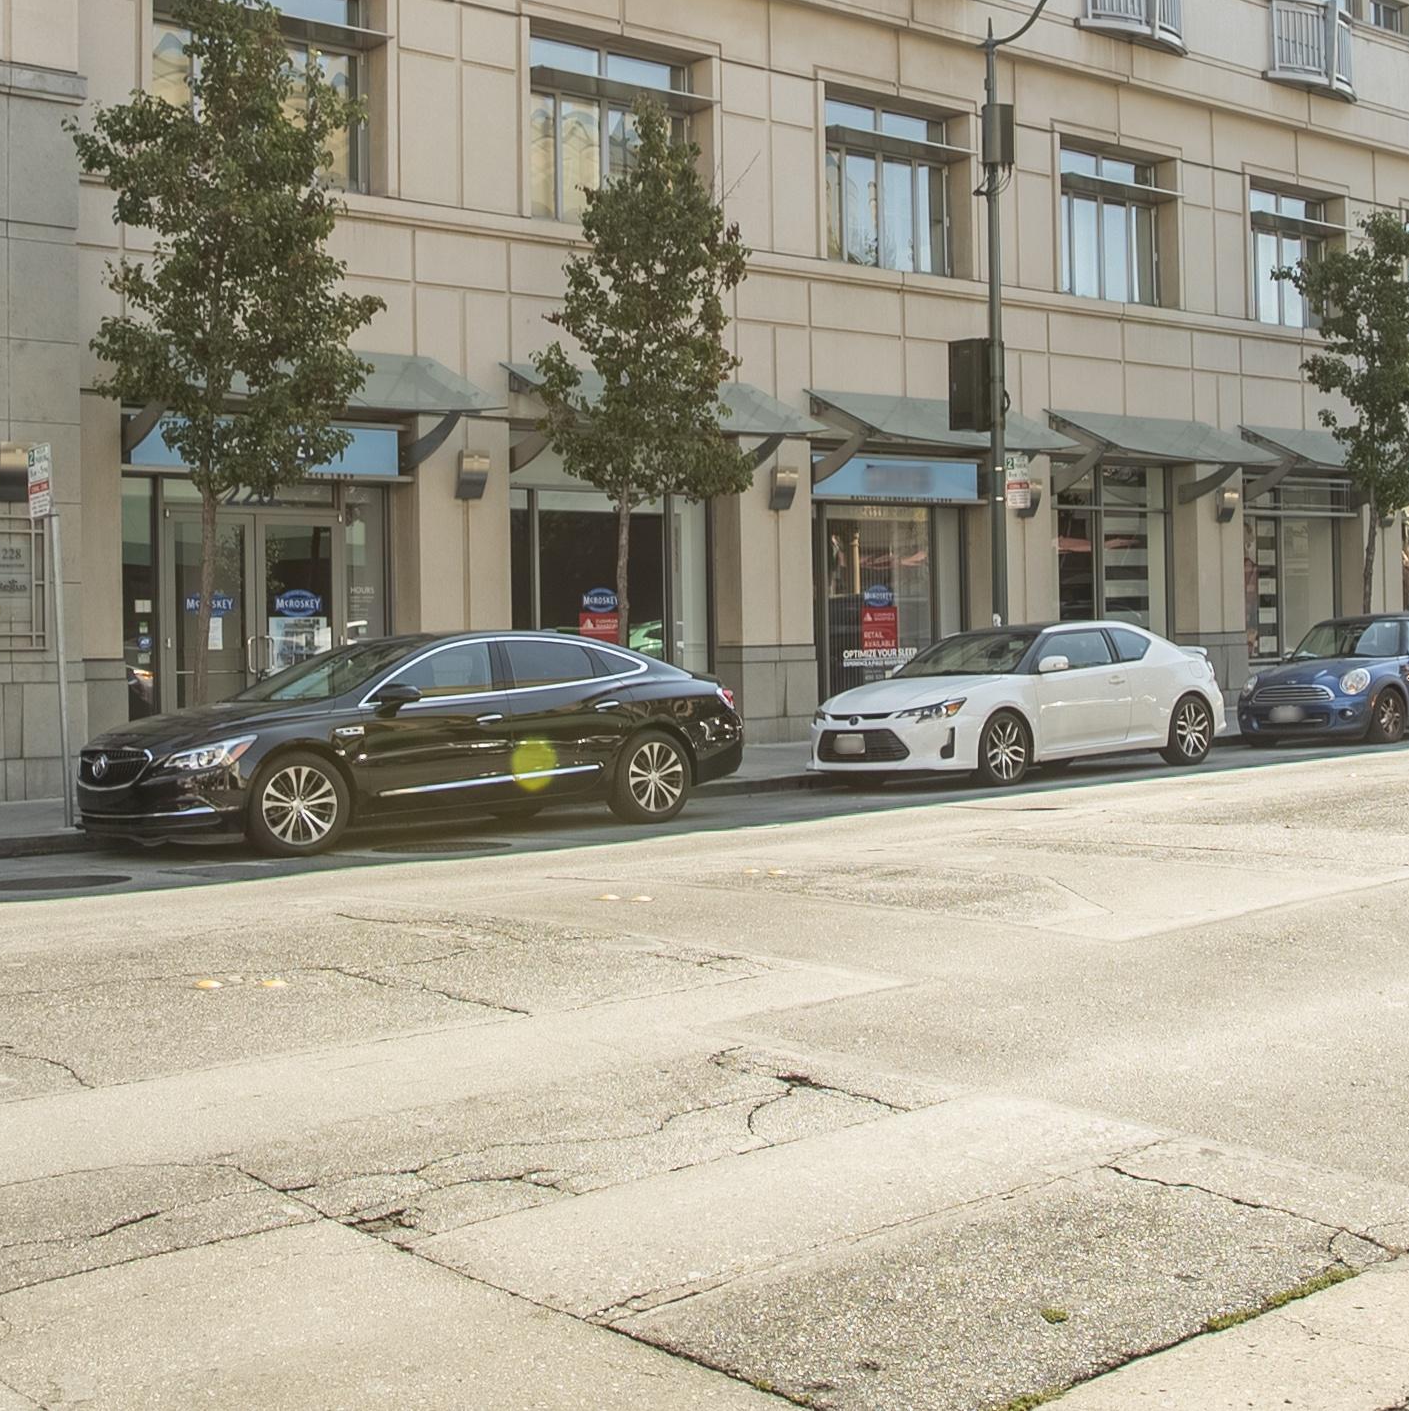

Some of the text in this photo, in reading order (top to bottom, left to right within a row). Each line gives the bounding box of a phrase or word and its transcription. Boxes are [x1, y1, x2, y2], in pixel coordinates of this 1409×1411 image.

[2, 548, 22, 560] 228
[186, 598, 233, 610] McSKEY
[864, 631, 884, 639] RETAIL
[864, 639, 896, 647] AVAILABLE
[843, 647, 918, 659] OPTIMIZE YOUR SLEEP
